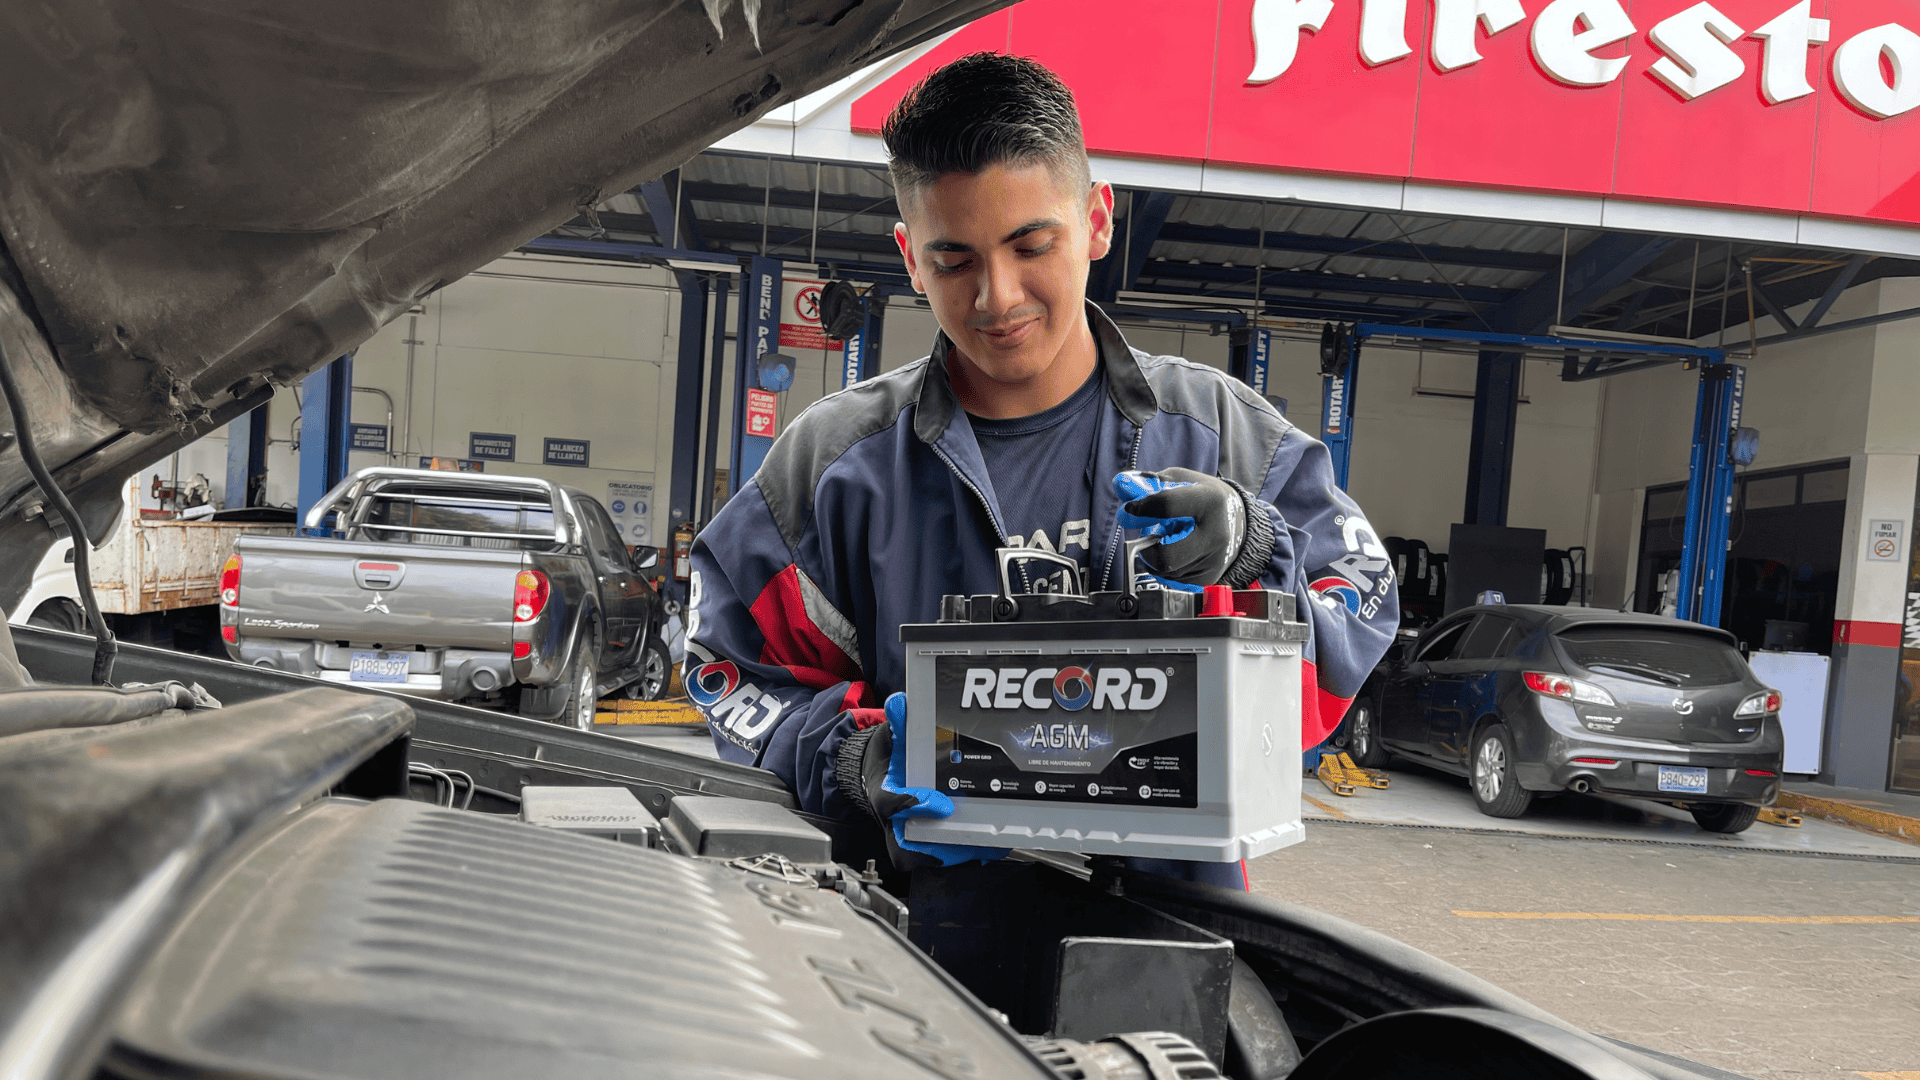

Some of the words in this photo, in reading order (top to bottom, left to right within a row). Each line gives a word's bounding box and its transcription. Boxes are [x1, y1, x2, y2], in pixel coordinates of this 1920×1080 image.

[1256, 331, 1268, 362] LIFT
[1328, 375, 1344, 427] ROTAR
[474, 446, 483, 454] DE
[484, 447, 510, 456] FALLAS
[549, 443, 585, 453] BALANCEO
[547, 451, 556, 459] DE
[557, 452, 585, 461] LLANTAS
[608, 482, 653, 491] OBLIGATORIO
[1881, 523, 1892, 531] NO
[1493, 593, 1501, 603] 17
[244, 617, 270, 627] L200
[270, 619, 320, 630] Sportero
[1030, 723, 1090, 749] AGM
